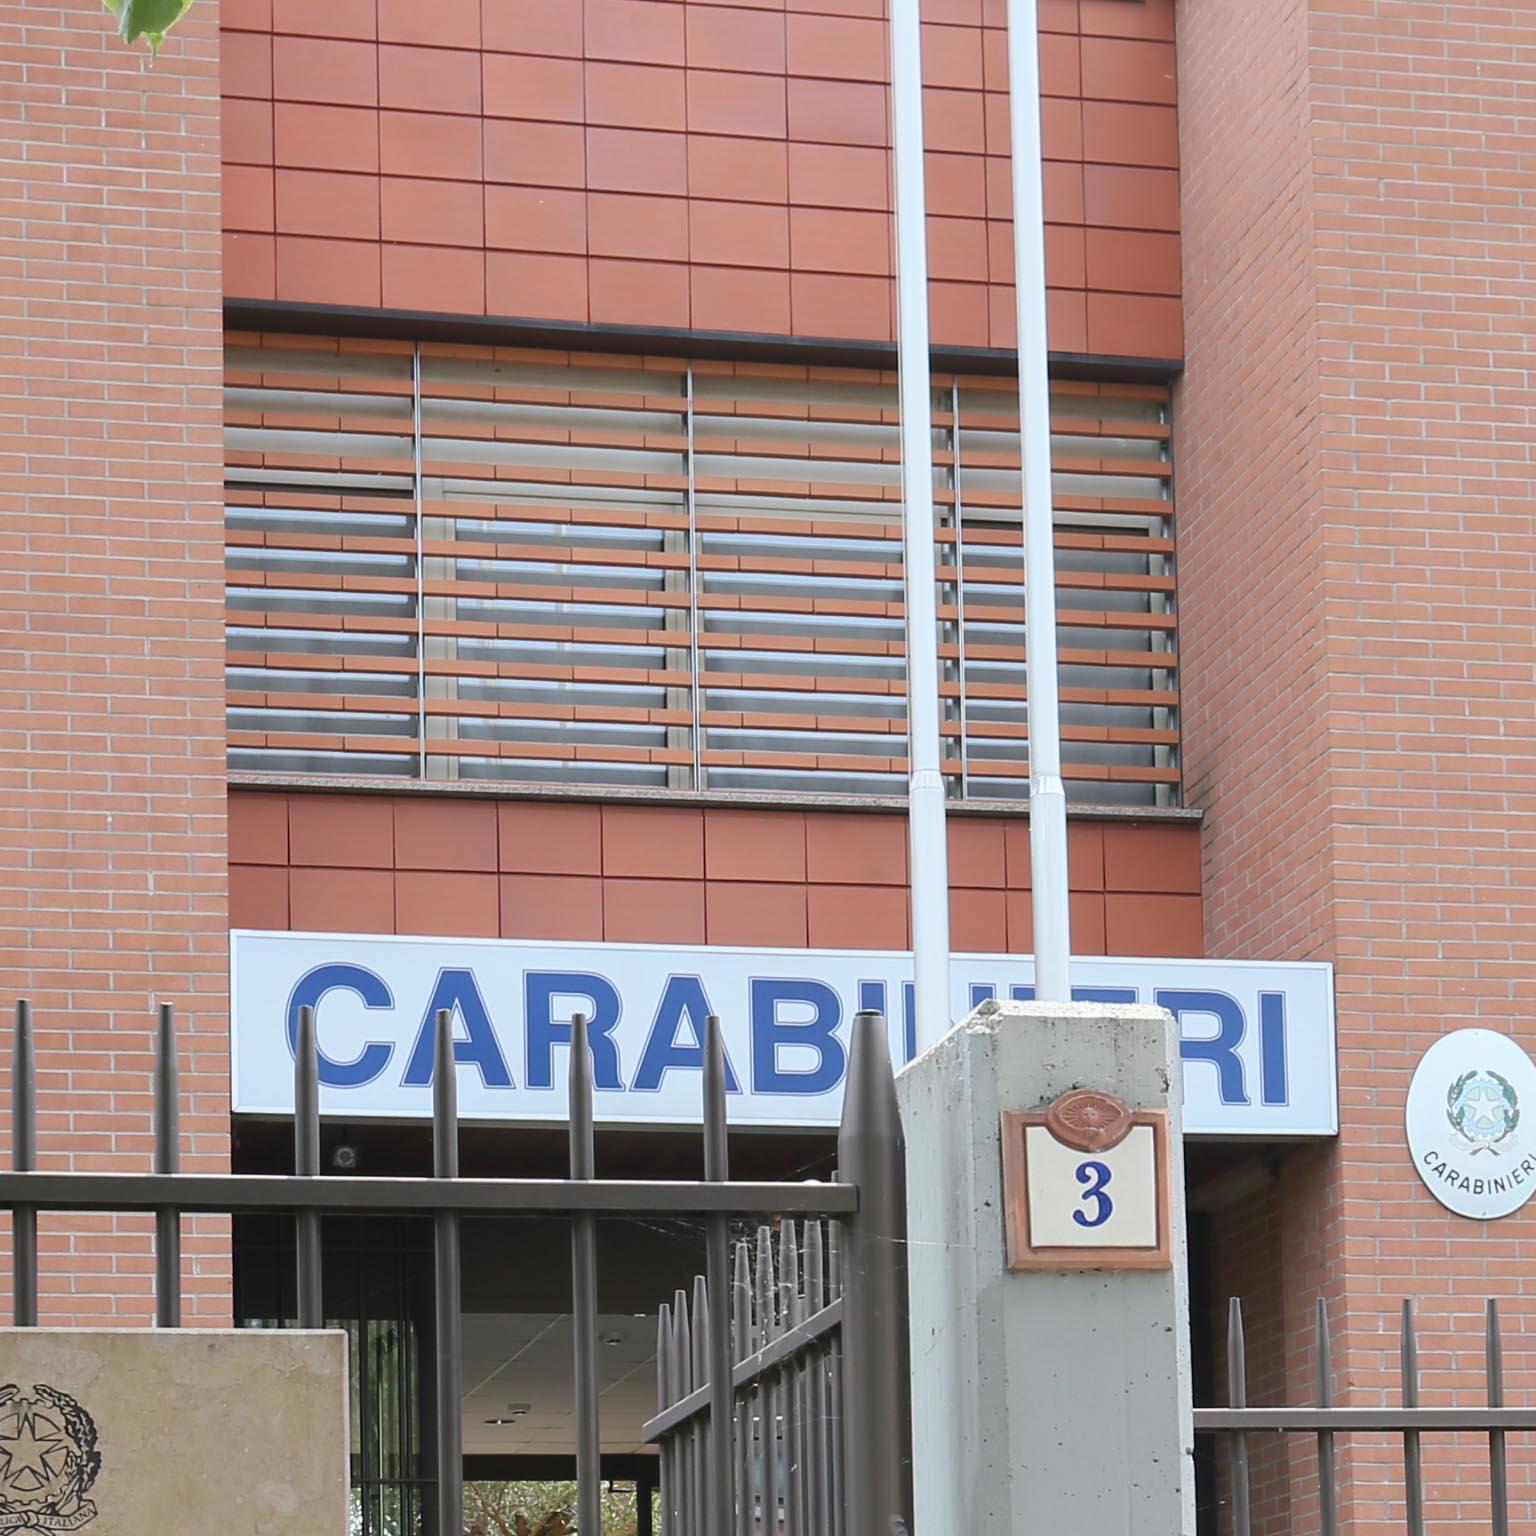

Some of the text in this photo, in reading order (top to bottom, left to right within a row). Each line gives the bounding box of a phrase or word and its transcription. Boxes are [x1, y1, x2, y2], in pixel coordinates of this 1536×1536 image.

[284, 961, 1290, 1108] CARABRI
[1072, 1160, 1114, 1228] 3
[43, 1506, 95, 1527] ITALIANA
